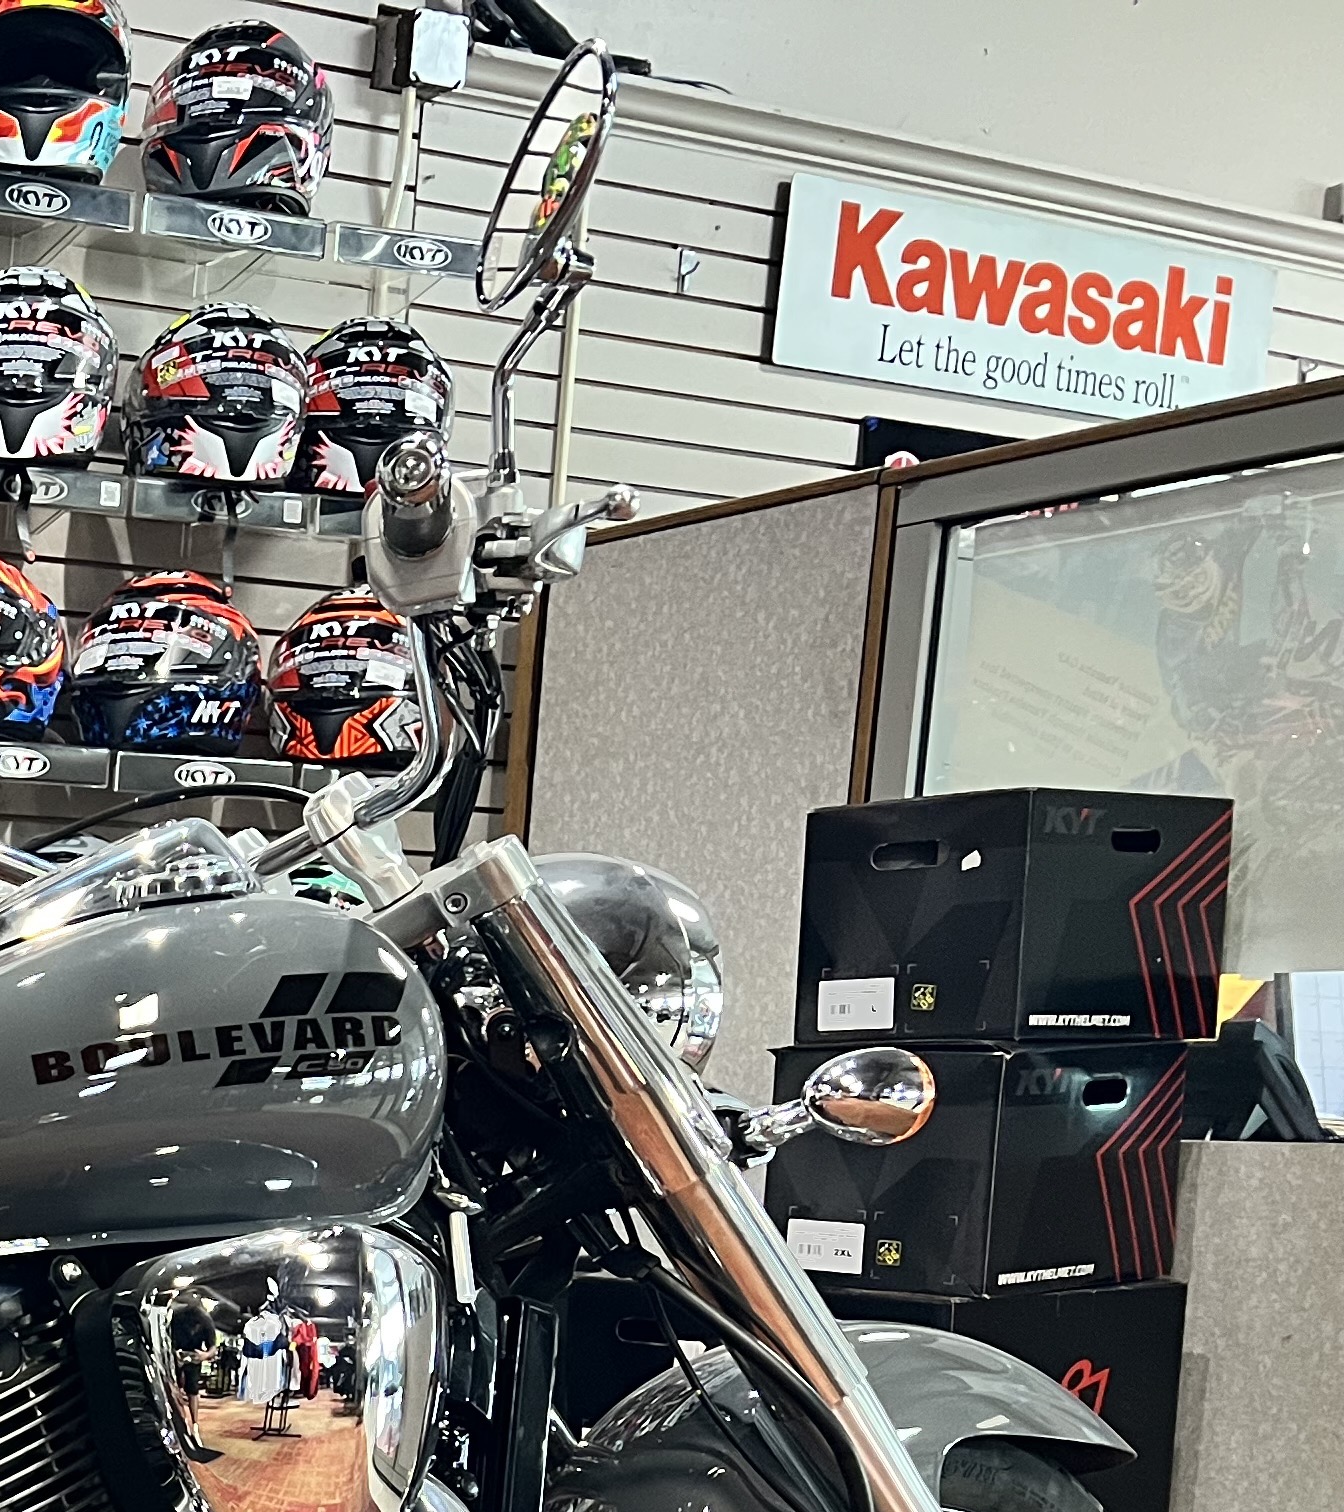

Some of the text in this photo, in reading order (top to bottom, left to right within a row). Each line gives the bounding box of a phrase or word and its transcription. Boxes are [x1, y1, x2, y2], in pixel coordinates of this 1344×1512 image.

[189, 46, 250, 69] KYT
[214, 216, 259, 238] KYT
[398, 247, 446, 264] KYT
[830, 200, 1234, 367] Kawasaki
[212, 329, 276, 349] KYT
[346, 346, 408, 363] KYT
[877, 323, 924, 368] Let
[933, 335, 976, 377] the
[985, 352, 1049, 391] good
[1055, 356, 1125, 403] times
[109, 602, 170, 621] KYT
[311, 620, 375, 639] KYT
[191, 700, 241, 723] KYT
[1043, 806, 1108, 836] KYT
[31, 1015, 402, 1086] BOULEVARD
[833, 1248, 852, 1259] 2XL
